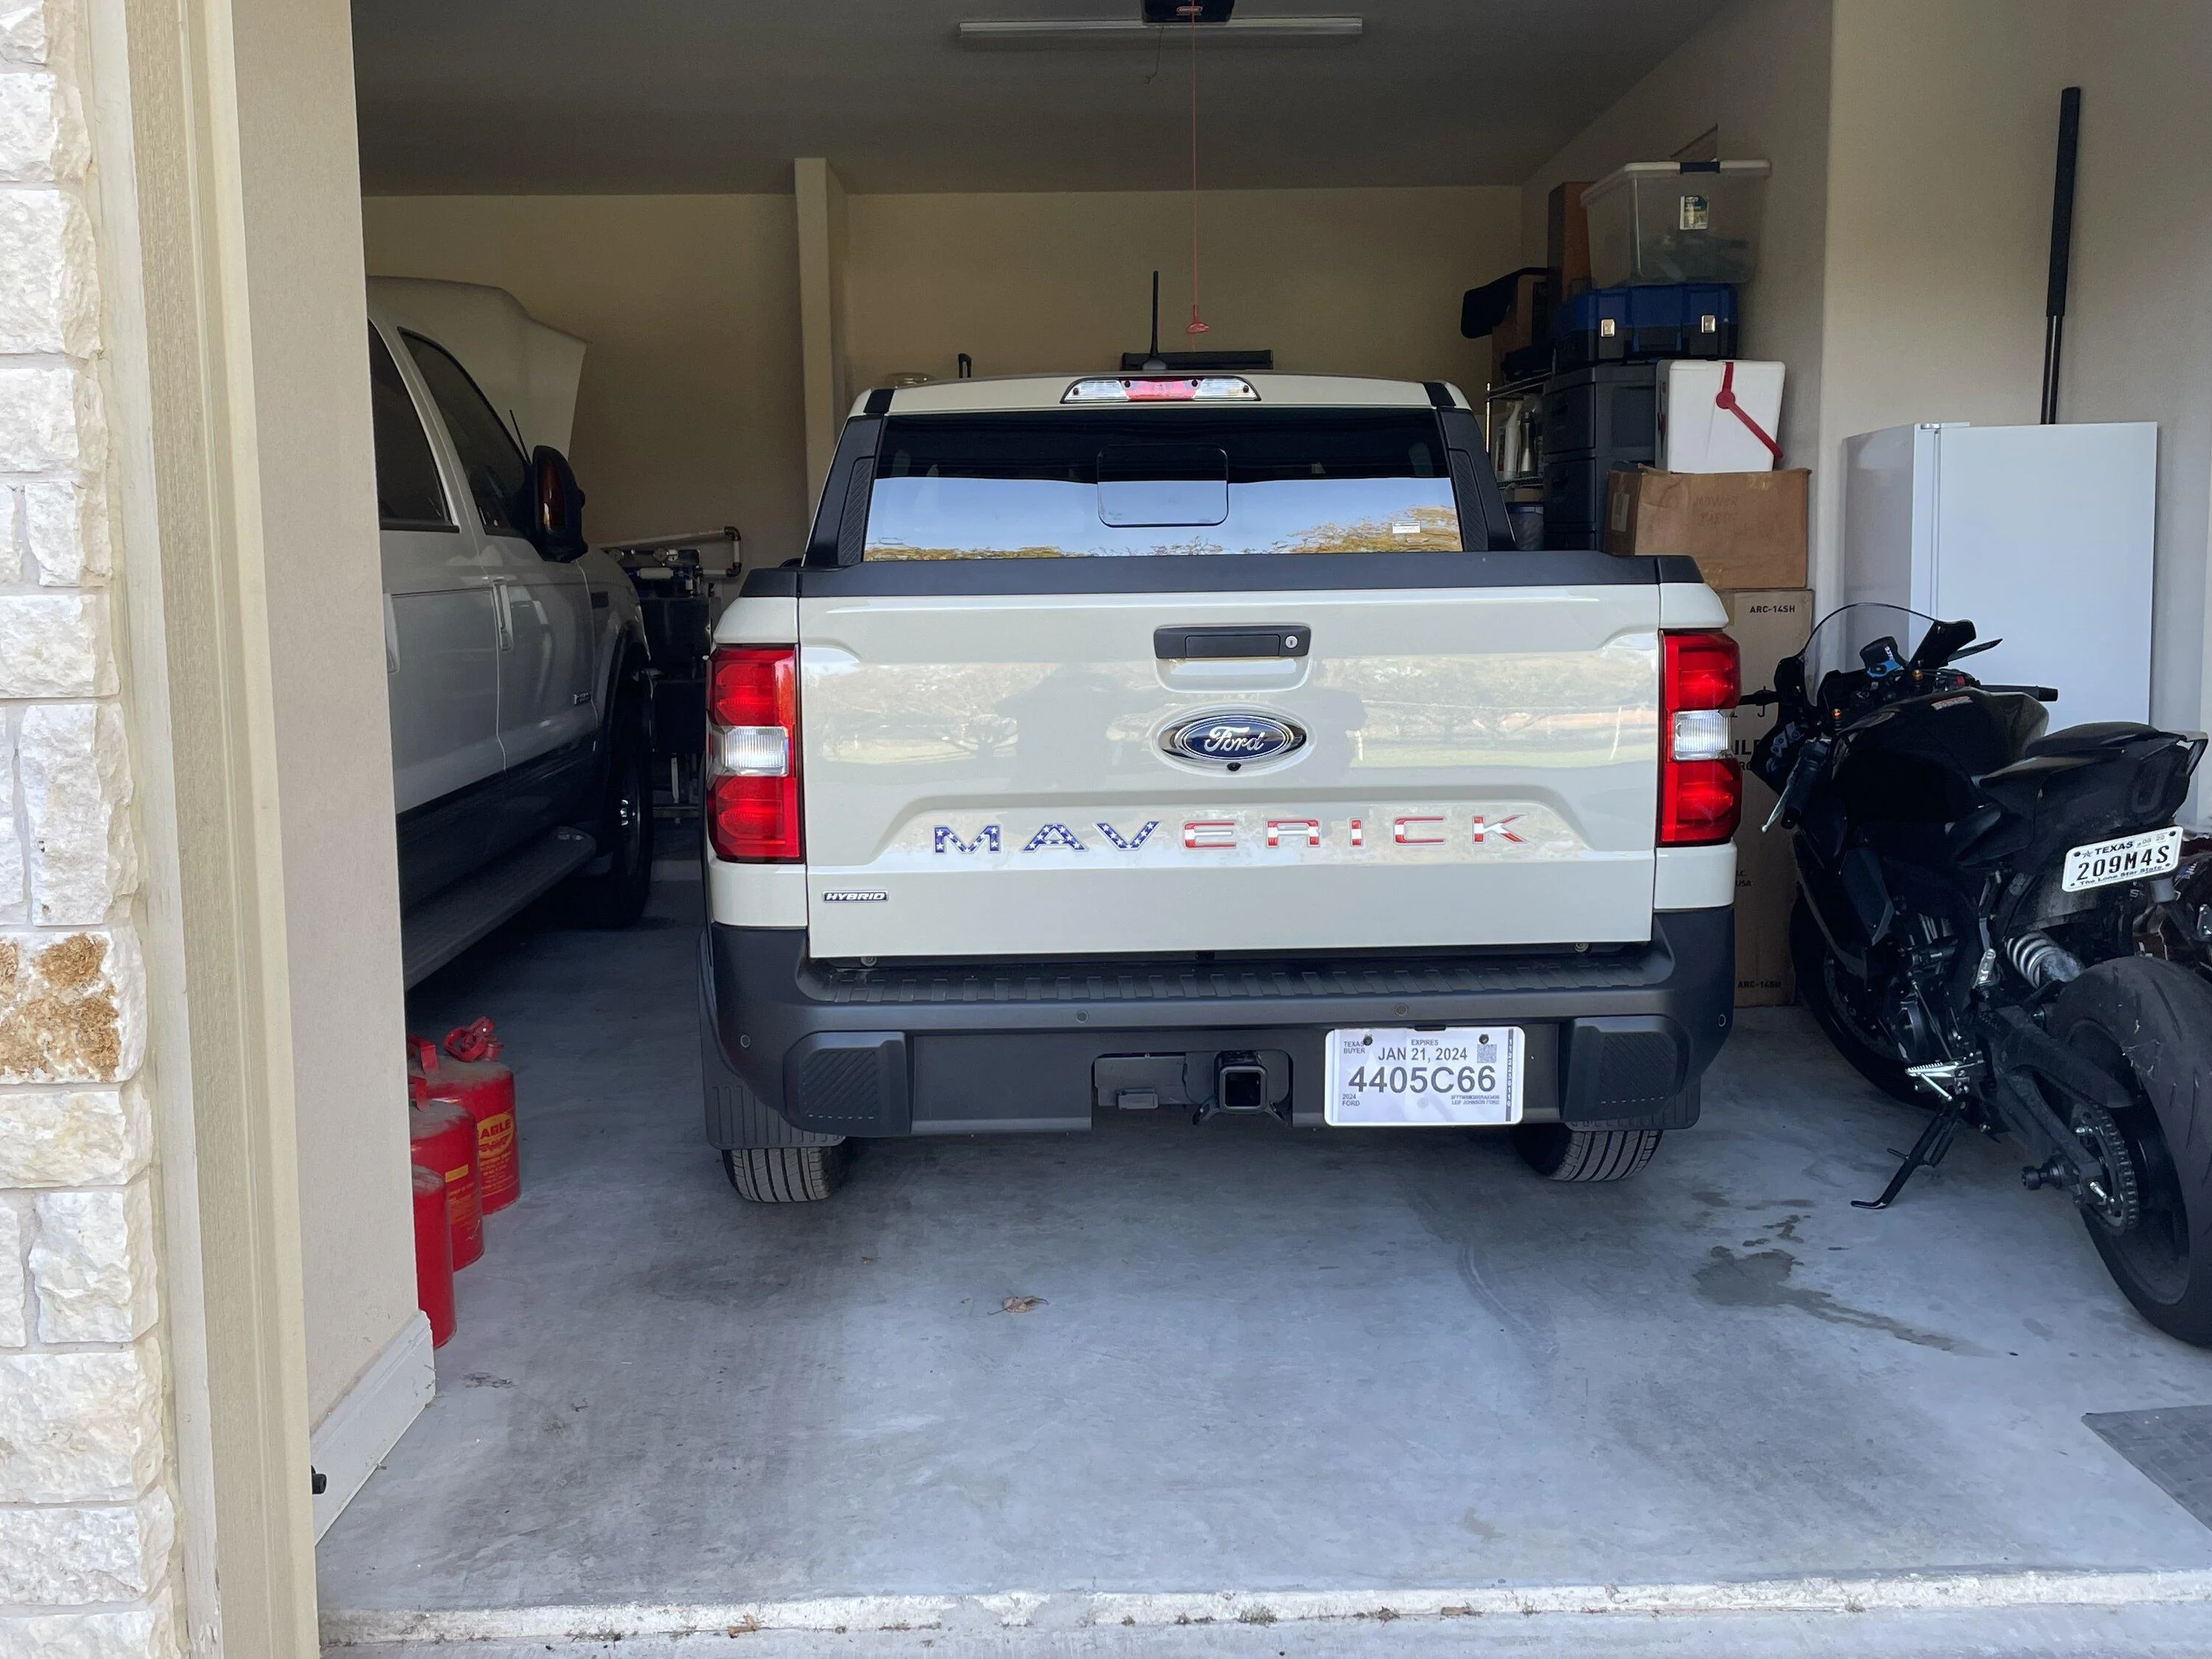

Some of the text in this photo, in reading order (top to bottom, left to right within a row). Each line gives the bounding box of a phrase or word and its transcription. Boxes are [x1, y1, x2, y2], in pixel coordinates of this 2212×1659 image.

[1203, 726, 1265, 752] Ford
[932, 815, 1526, 854] MAVERICK
[2095, 841, 2133, 855] TEXAS
[2076, 845, 2169, 881] 209M4S
[2080, 877, 2096, 886] The
[2098, 873, 2118, 882] Lone
[2140, 866, 2163, 874] State
[1378, 1047, 1467, 1062] JAN 21, 2024
[1348, 1065, 1496, 1093] 4405C66
[476, 1119, 511, 1139] AGLE
